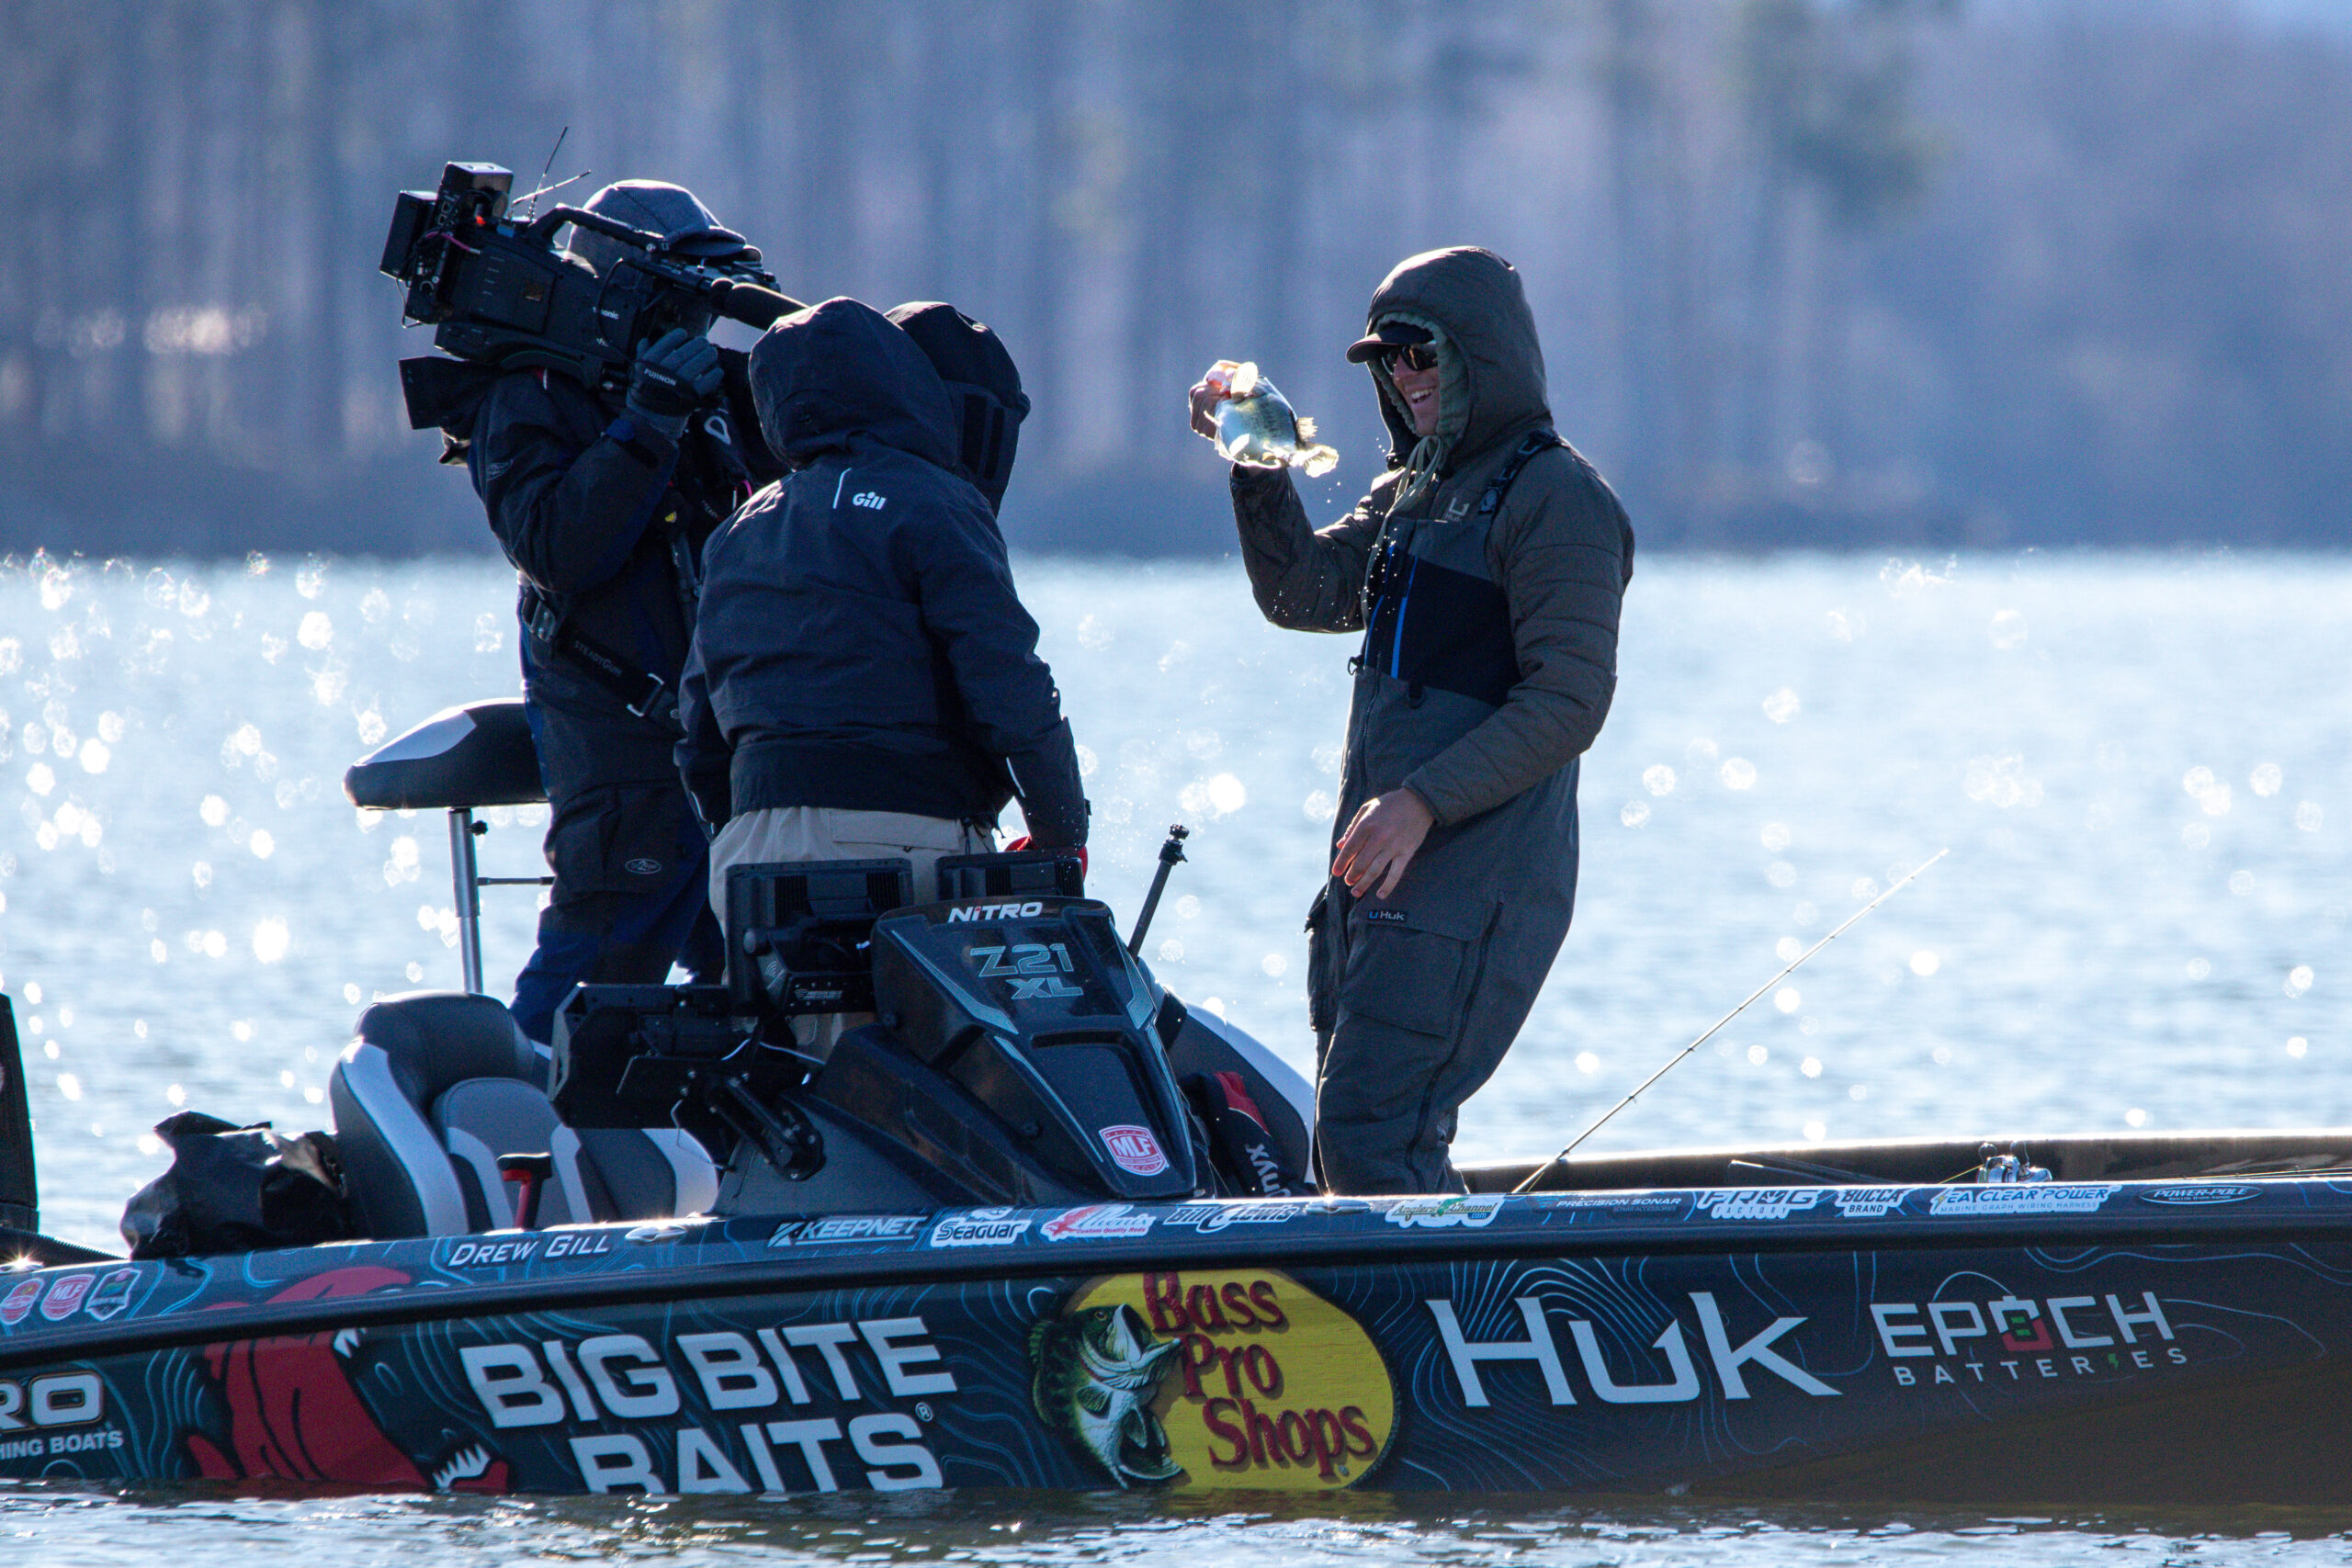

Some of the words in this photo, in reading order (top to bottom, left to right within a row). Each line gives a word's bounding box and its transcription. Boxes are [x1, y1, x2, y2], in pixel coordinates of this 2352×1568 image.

[644, 367, 677, 387] FUJINON
[852, 491, 887, 511] Gill
[947, 902, 1044, 923] NITRO
[969, 942, 1074, 977] Z21
[1005, 976, 1084, 999] XL
[1111, 1135, 1154, 1157] MLF
[1556, 1199, 1629, 1208] PRECISION
[1631, 1198, 1682, 1206] SONAR
[1841, 1190, 1901, 1202] BUCCA
[1980, 1190, 2037, 1201] CLEAR
[2042, 1189, 2109, 1200] POWER
[2154, 1188, 2250, 1198] POWER-POLE
[1849, 1205, 1883, 1213] BRAND
[797, 1216, 928, 1239] KEEPNET
[448, 1241, 539, 1267] DREW
[545, 1235, 609, 1258] GILL
[1142, 1271, 1285, 1332] Bass
[1870, 1292, 2175, 1357] EPOCH
[1426, 1292, 1842, 1407] Huk
[460, 1334, 680, 1428] BIG
[676, 1316, 957, 1411] BITE
[1180, 1332, 1281, 1399] Pro
[50, 1429, 124, 1454] BOATS
[1202, 1396, 1375, 1479] Shops
